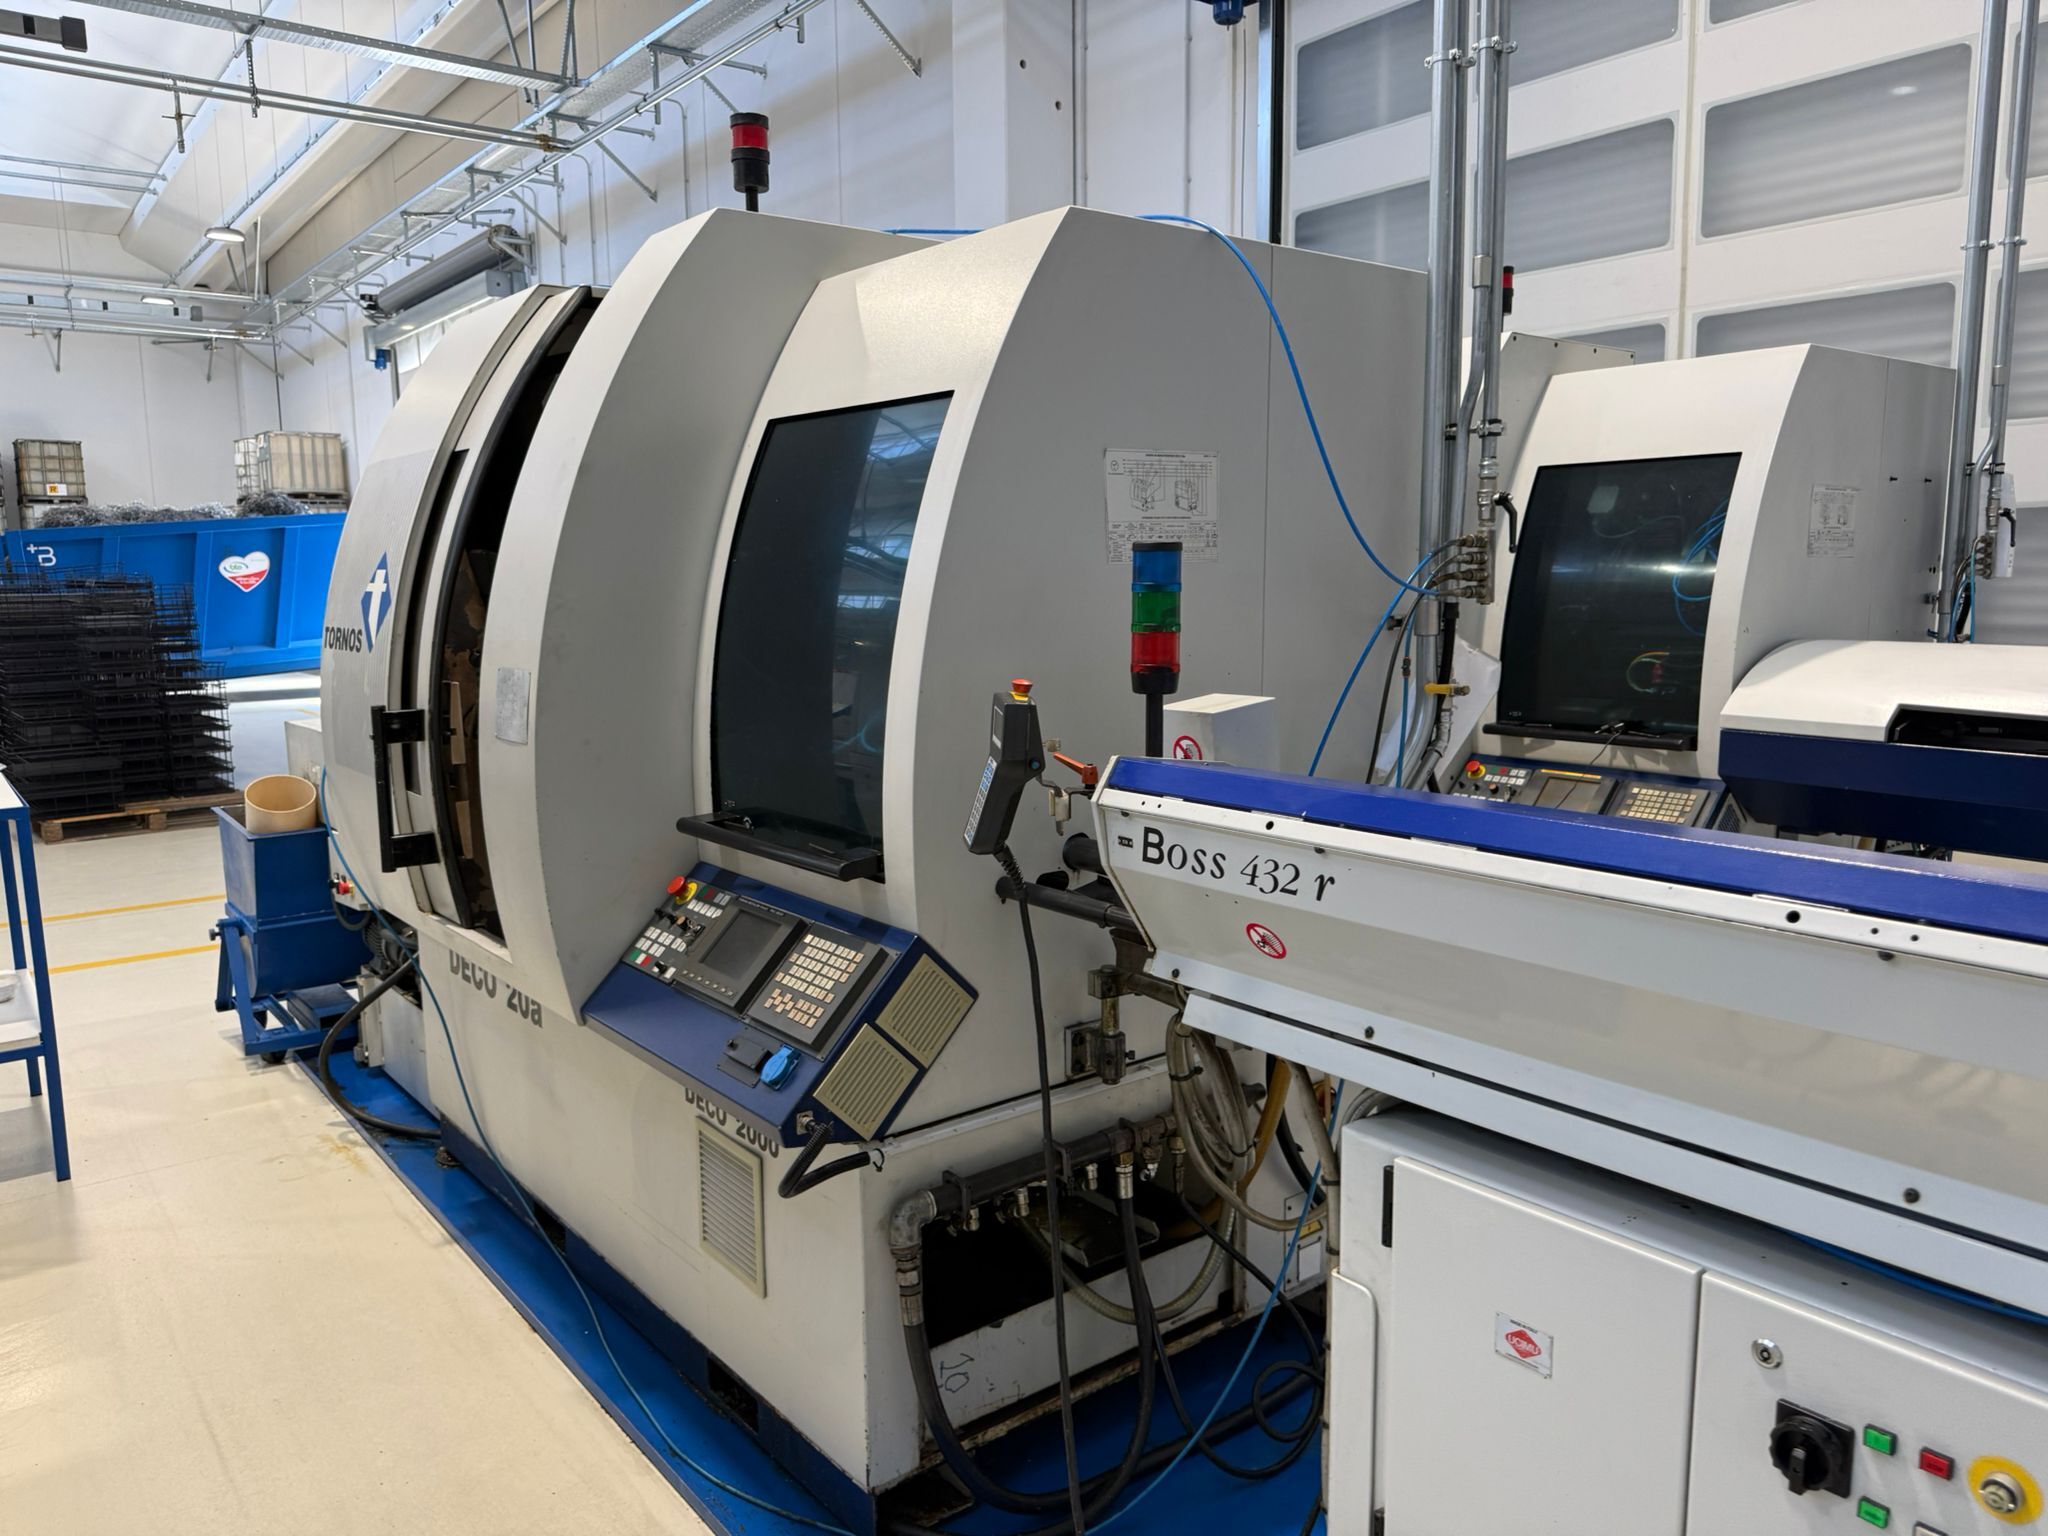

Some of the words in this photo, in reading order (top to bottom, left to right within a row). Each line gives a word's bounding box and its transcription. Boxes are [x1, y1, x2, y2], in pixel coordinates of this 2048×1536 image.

[324, 626, 363, 654] TORNOS
[1240, 855, 1301, 896] 432
[1314, 874, 1336, 902] r
[449, 949, 498, 999] DECO
[685, 1088, 728, 1127] DECO
[735, 1119, 780, 1159] 2000
